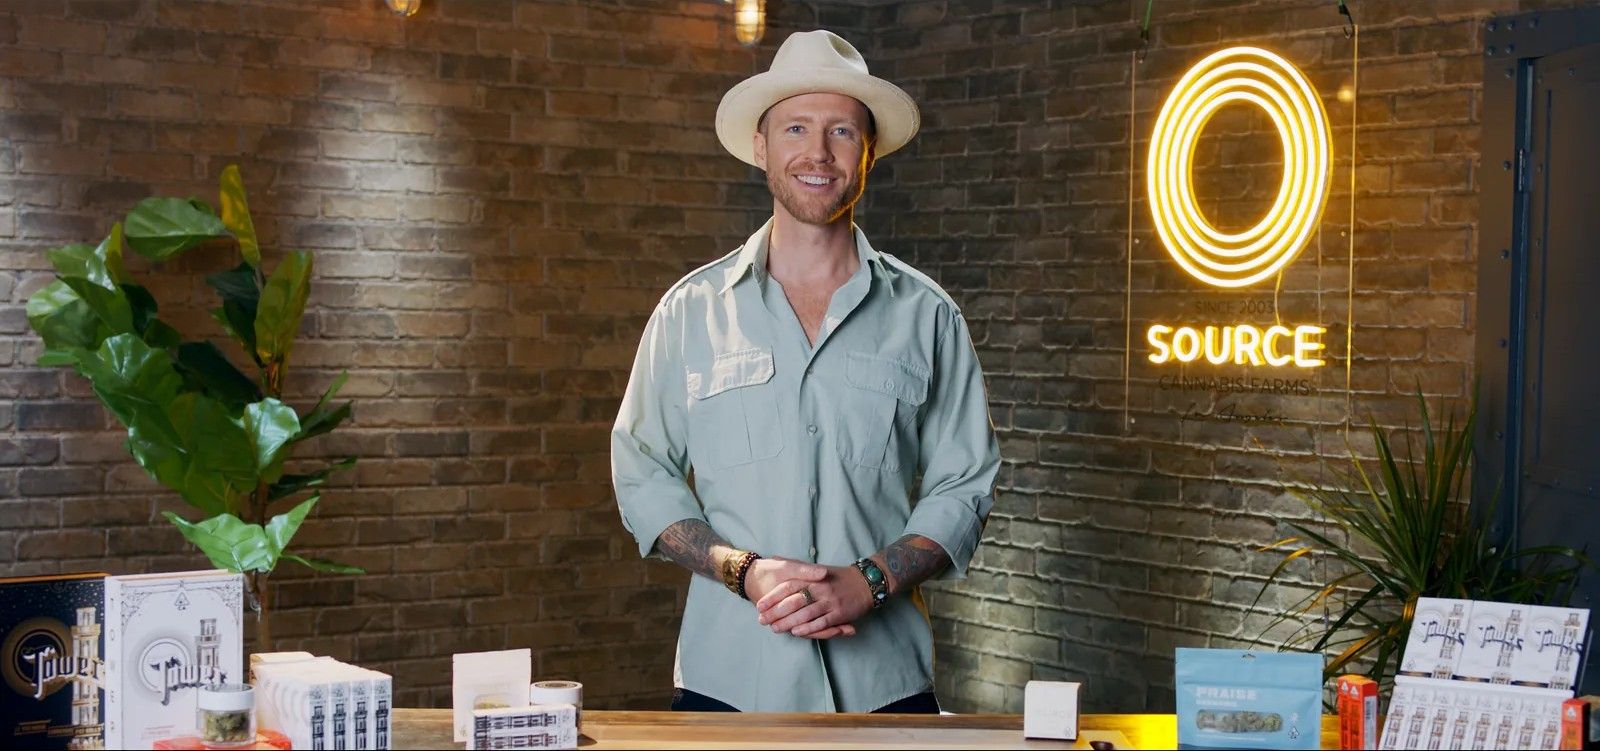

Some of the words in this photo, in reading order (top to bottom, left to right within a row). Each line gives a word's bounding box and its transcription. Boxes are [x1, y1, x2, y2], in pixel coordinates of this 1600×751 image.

[1194, 299, 1235, 314] SINCE
[1239, 299, 1275, 315] 2003
[1147, 324, 1327, 368] SOURCE
[1158, 374, 1245, 394] CANNABIS
[1249, 377, 1311, 397] FARMS
[1195, 685, 1257, 701] PRAISE
